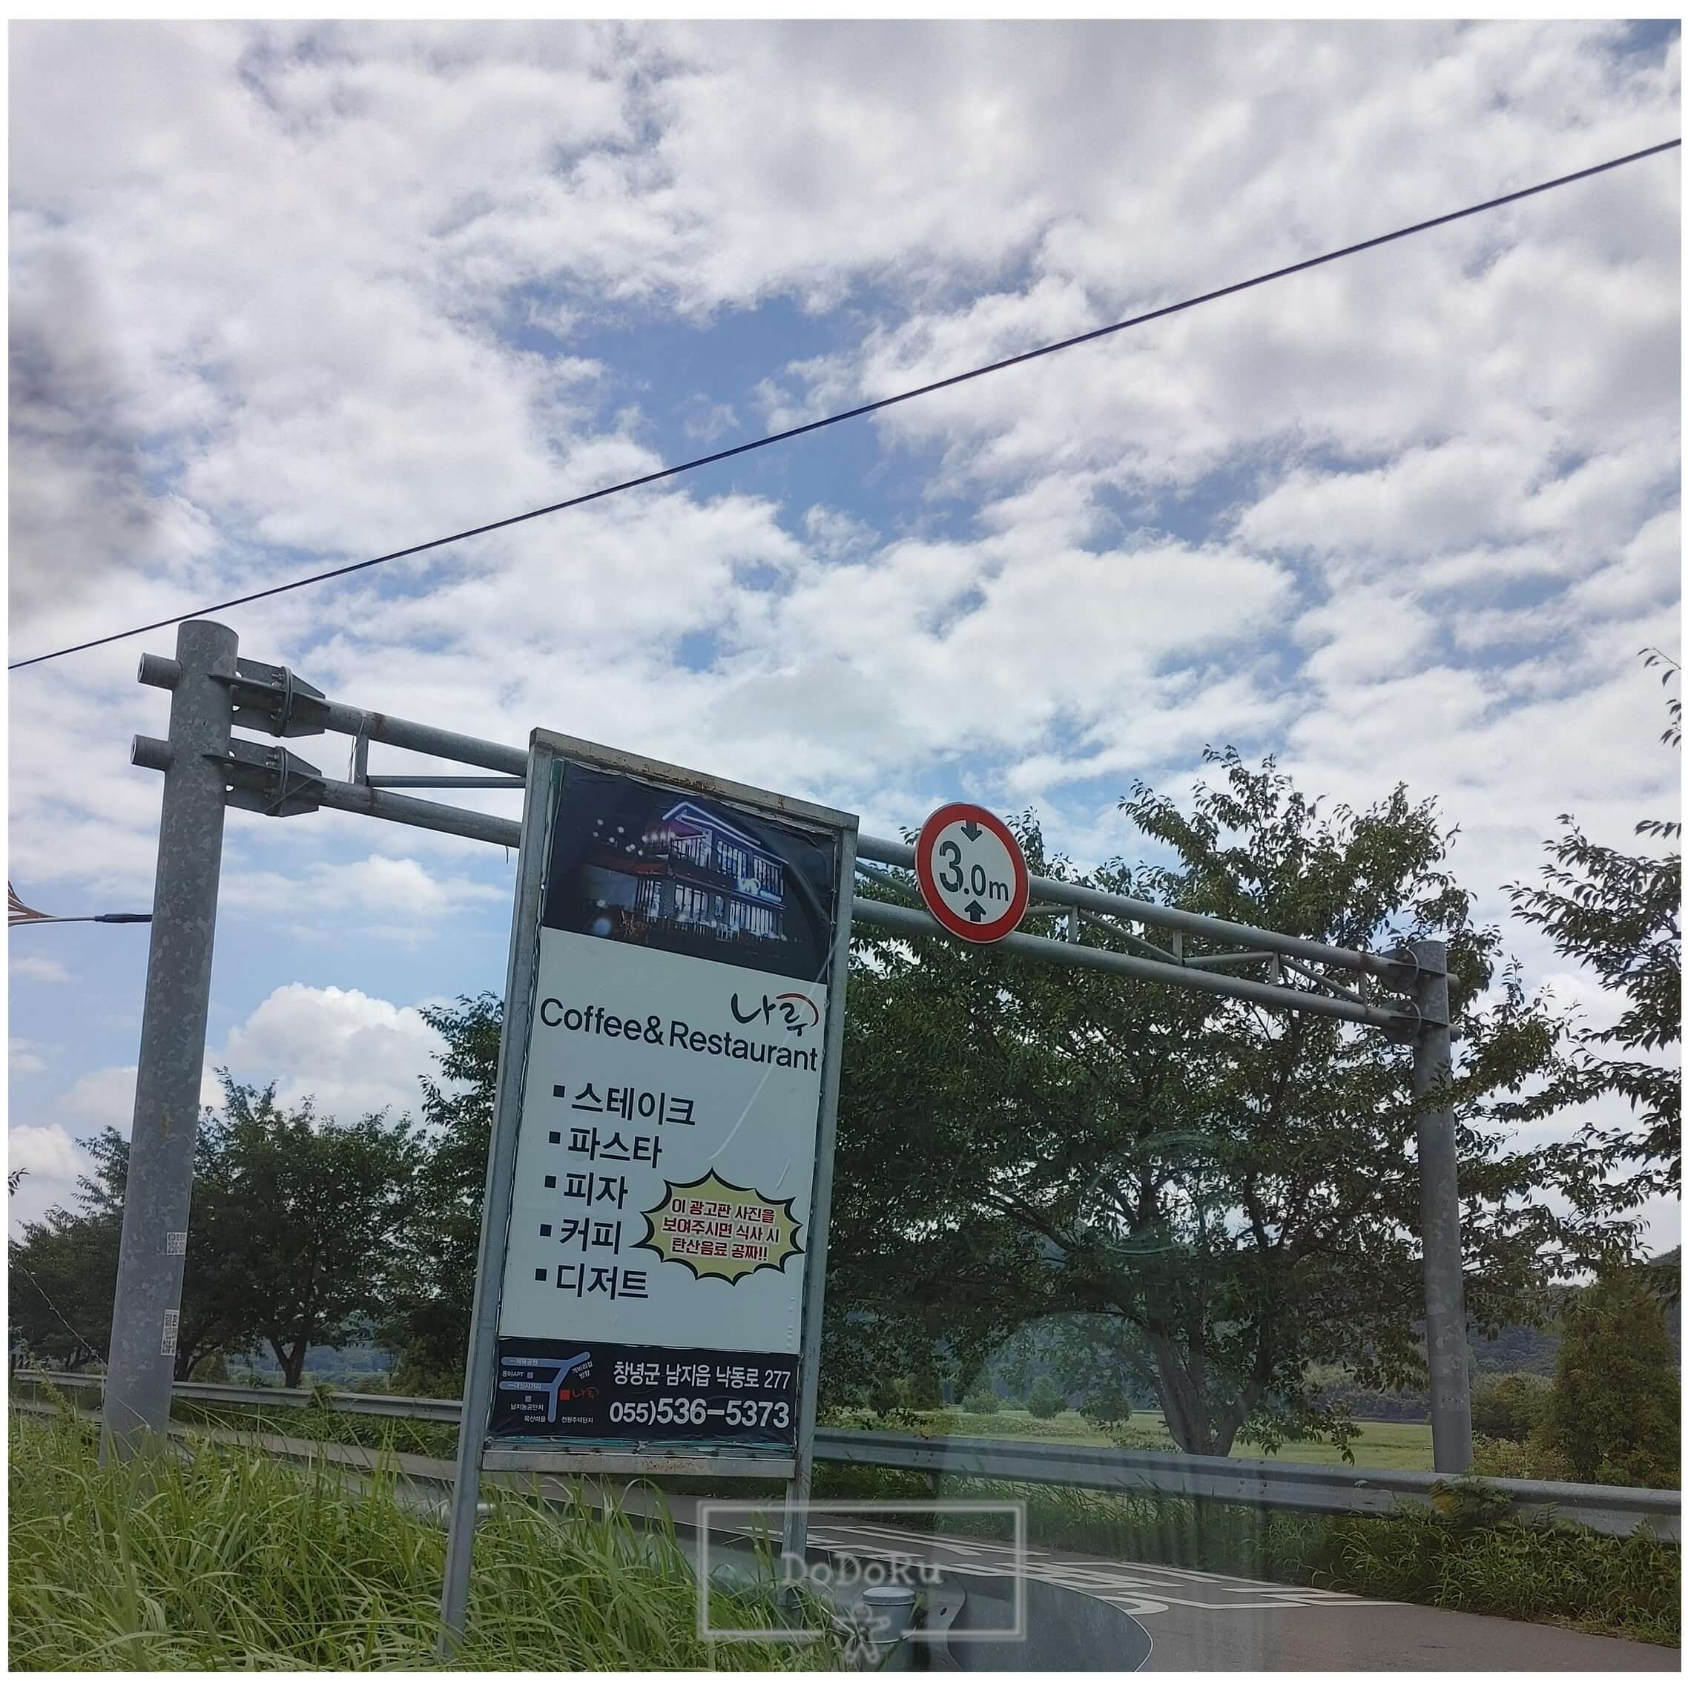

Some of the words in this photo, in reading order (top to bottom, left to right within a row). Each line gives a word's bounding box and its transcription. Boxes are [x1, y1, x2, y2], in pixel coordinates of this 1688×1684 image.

[939, 840, 1009, 902] 3.0m
[571, 1083, 697, 1126] 스테이크
[567, 1126, 663, 1169] 파스타
[563, 1172, 629, 1210] 피자
[671, 1198, 685, 1214] 이
[689, 1200, 732, 1218] 광고판
[734, 1205, 776, 1223] 사진을
[559, 1217, 622, 1255] 커피
[662, 1217, 733, 1238] 보여주시면
[736, 1224, 763, 1241] 식사
[766, 1228, 780, 1243] 시
[671, 1237, 728, 1257] 탄산음료
[731, 1244, 768, 1261] 공짜!!
[556, 1263, 649, 1300] 디저트
[613, 1360, 661, 1386] 창녕군
[666, 1364, 711, 1388] 남지읍
[716, 1366, 760, 1389] 낙동로
[764, 1369, 791, 1390] 277
